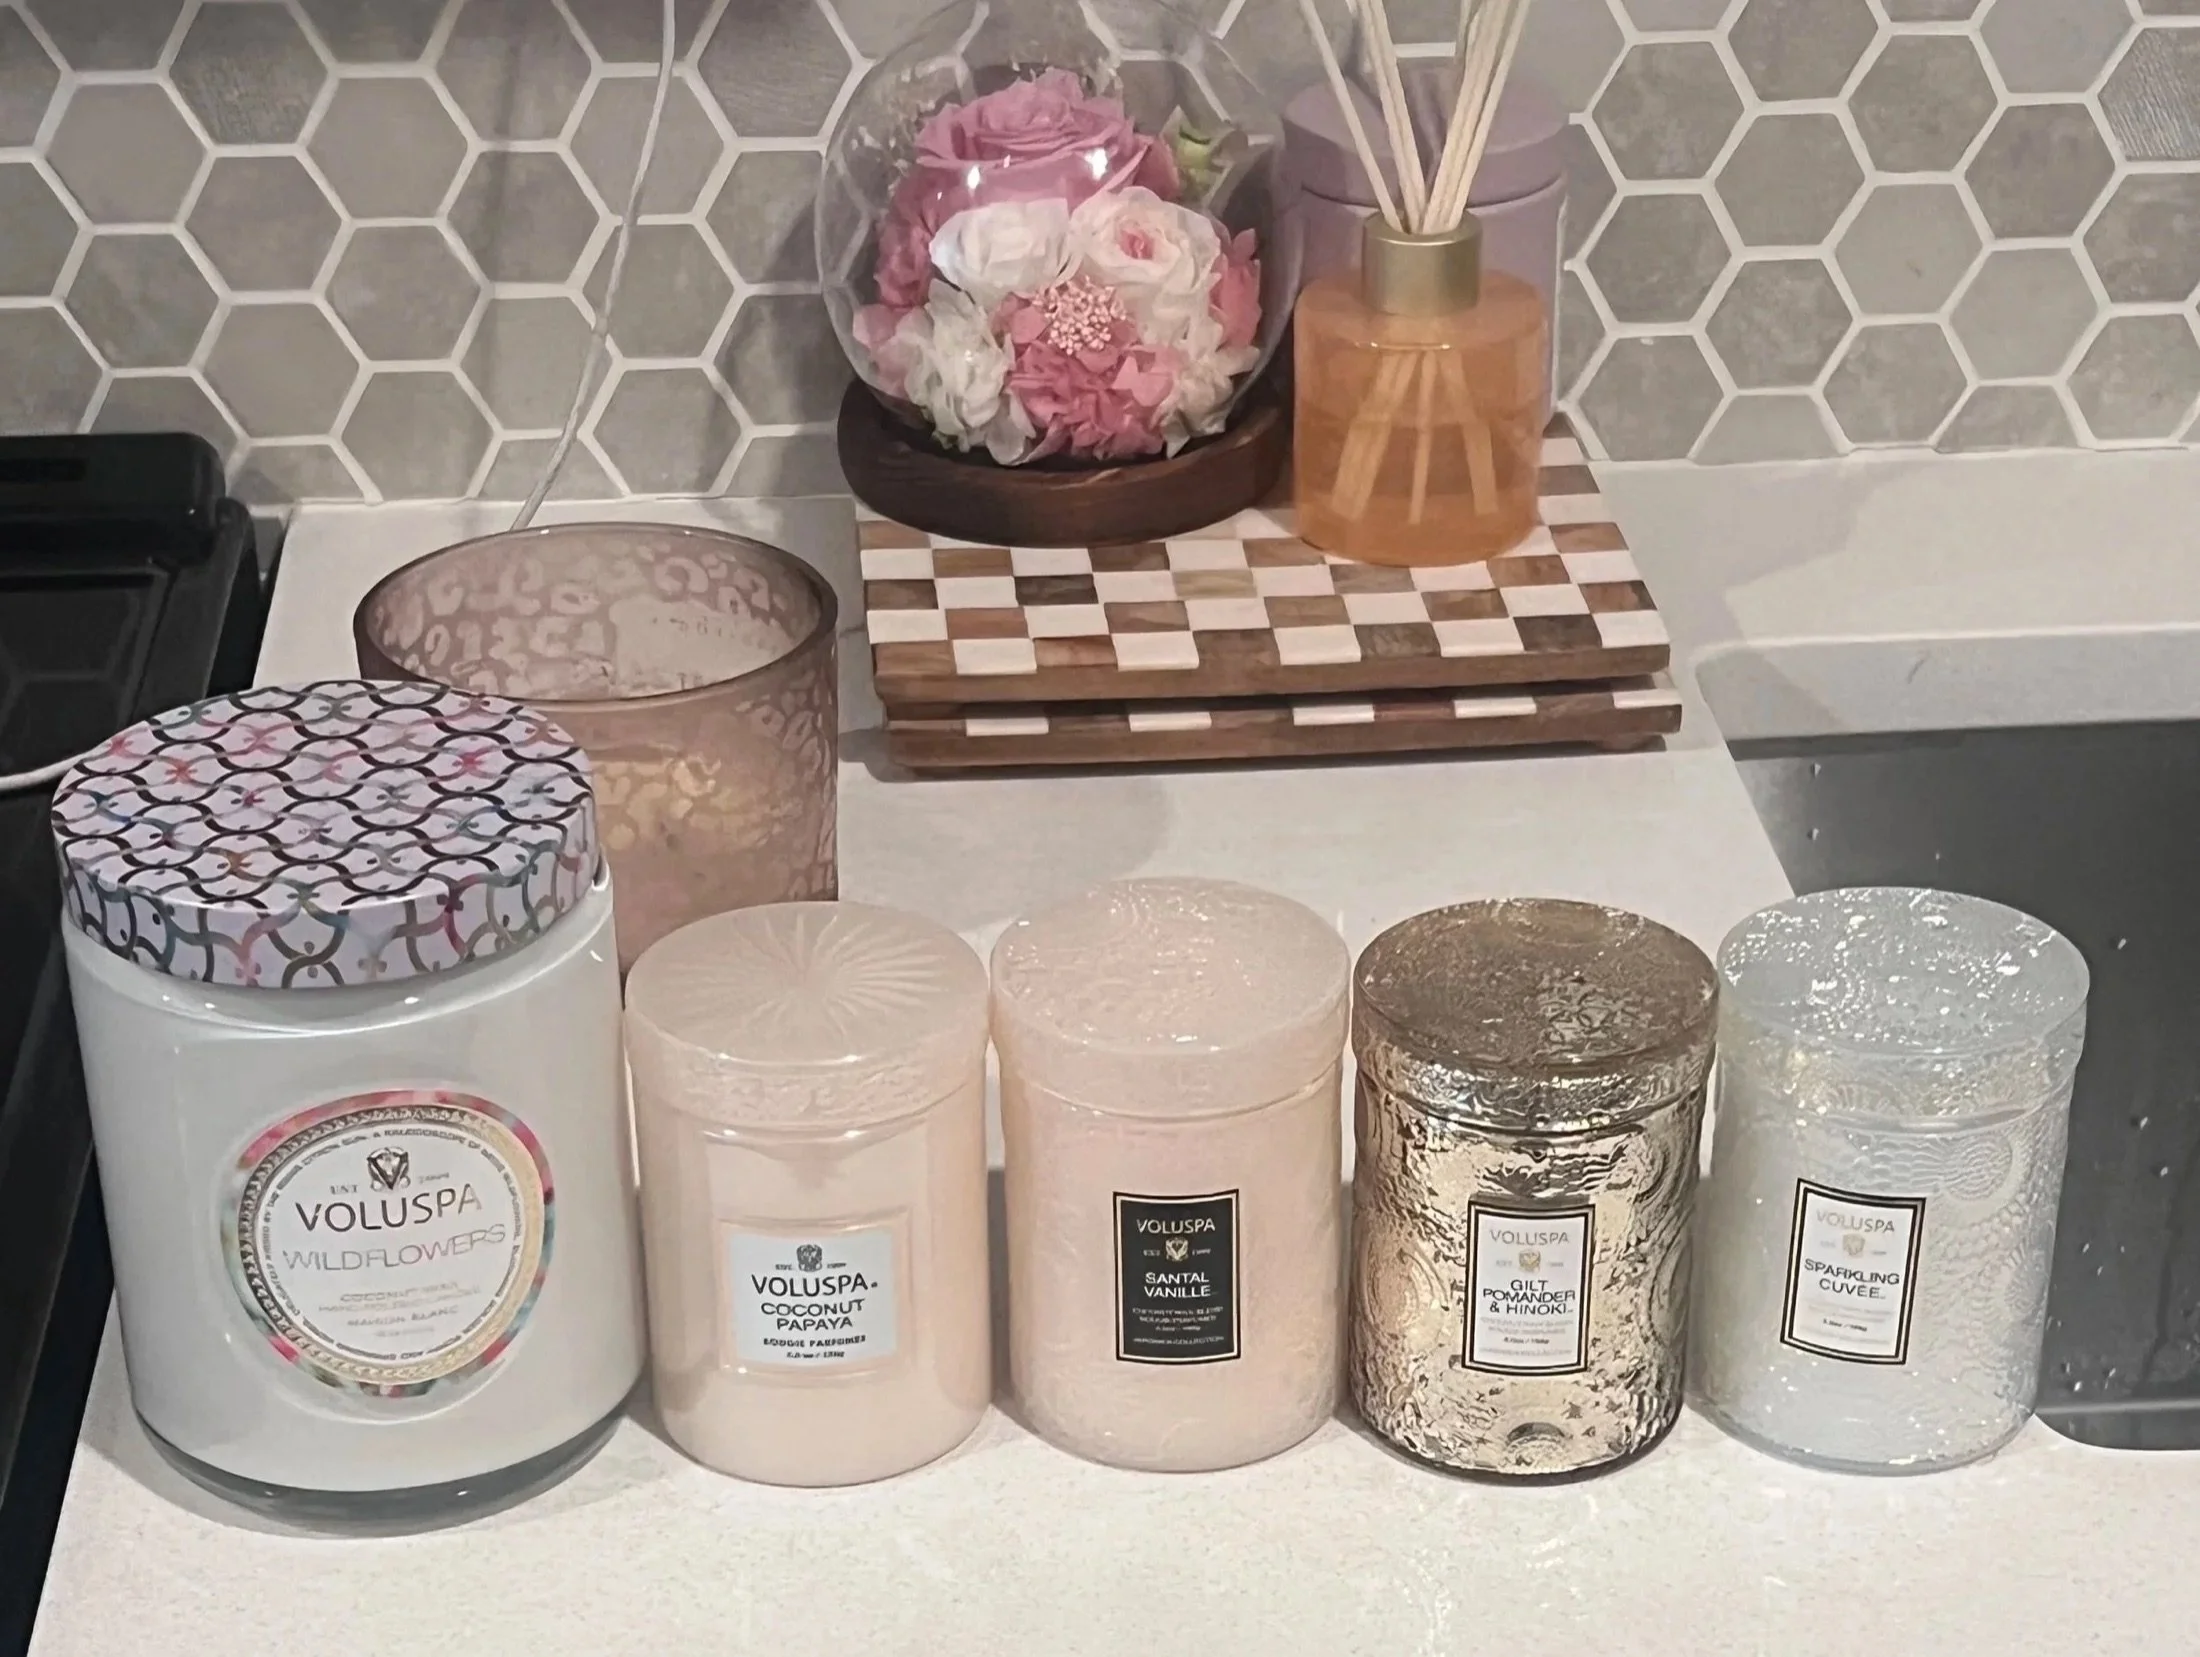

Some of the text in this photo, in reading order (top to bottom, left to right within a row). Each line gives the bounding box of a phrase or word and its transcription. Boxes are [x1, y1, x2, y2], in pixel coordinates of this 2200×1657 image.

[295, 1183, 483, 1233] VOLUSPA
[1136, 1217, 1216, 1234] VOLUSPA
[1816, 1210, 1895, 1233] VOLUSPA
[1490, 1230, 1570, 1246] VOLUSPA
[282, 1223, 506, 1272] WILDFLOWERS
[1145, 1271, 1210, 1285] SANTAL
[1804, 1258, 1900, 1285] SPARKLING
[1144, 1285, 1212, 1298] VANILLE
[1510, 1279, 1549, 1292] GILT
[1483, 1288, 1576, 1304] POMANDER
[760, 1299, 866, 1317] COCONUT
[1490, 1301, 1566, 1315] & HINOKI
[776, 1317, 853, 1331] PAPAYA
